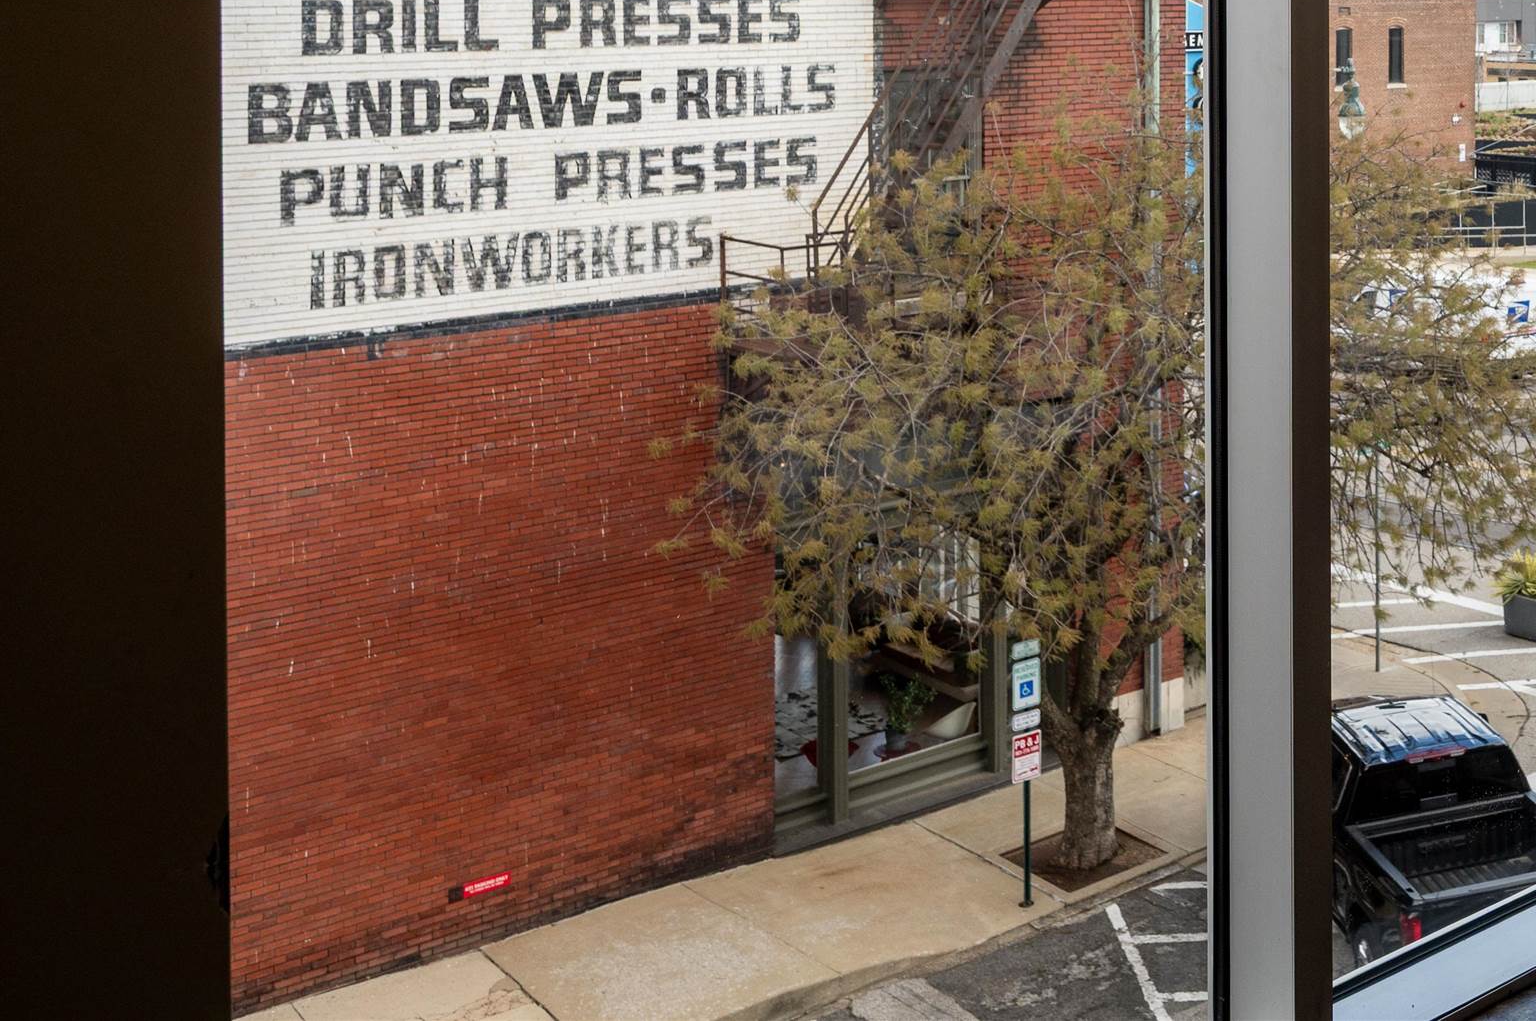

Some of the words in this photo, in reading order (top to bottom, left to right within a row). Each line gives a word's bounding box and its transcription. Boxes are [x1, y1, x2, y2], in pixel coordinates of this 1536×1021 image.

[248, 70, 642, 145] BANDSAWS
[676, 64, 836, 120] ROLLS
[280, 156, 508, 227] PUNCH
[554, 136, 818, 202] PRESSES
[311, 217, 714, 310] IRONWORKERS
